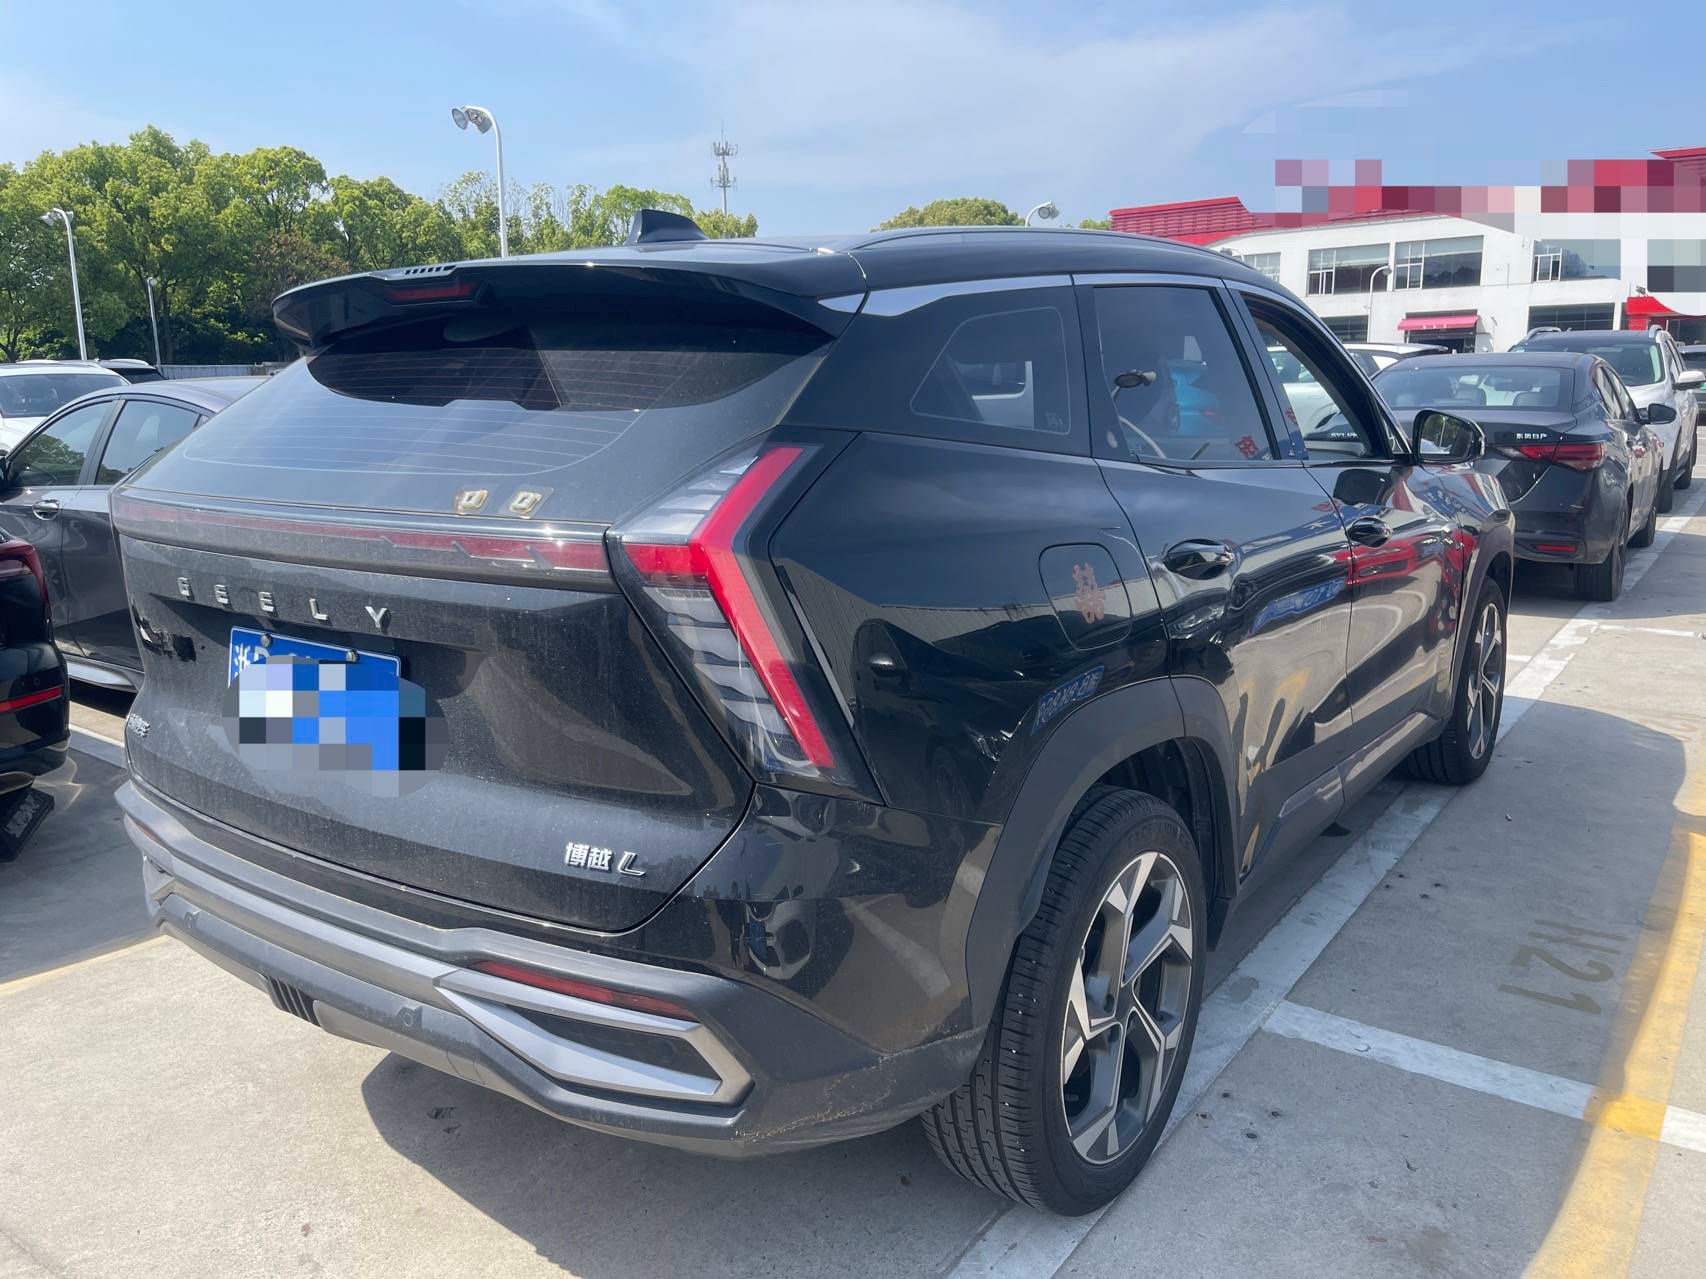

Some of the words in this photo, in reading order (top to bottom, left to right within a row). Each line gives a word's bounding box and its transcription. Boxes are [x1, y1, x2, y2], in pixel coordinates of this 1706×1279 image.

[177, 576, 388, 629] GEELY
[564, 841, 613, 872] 博越
[617, 850, 647, 876] L
